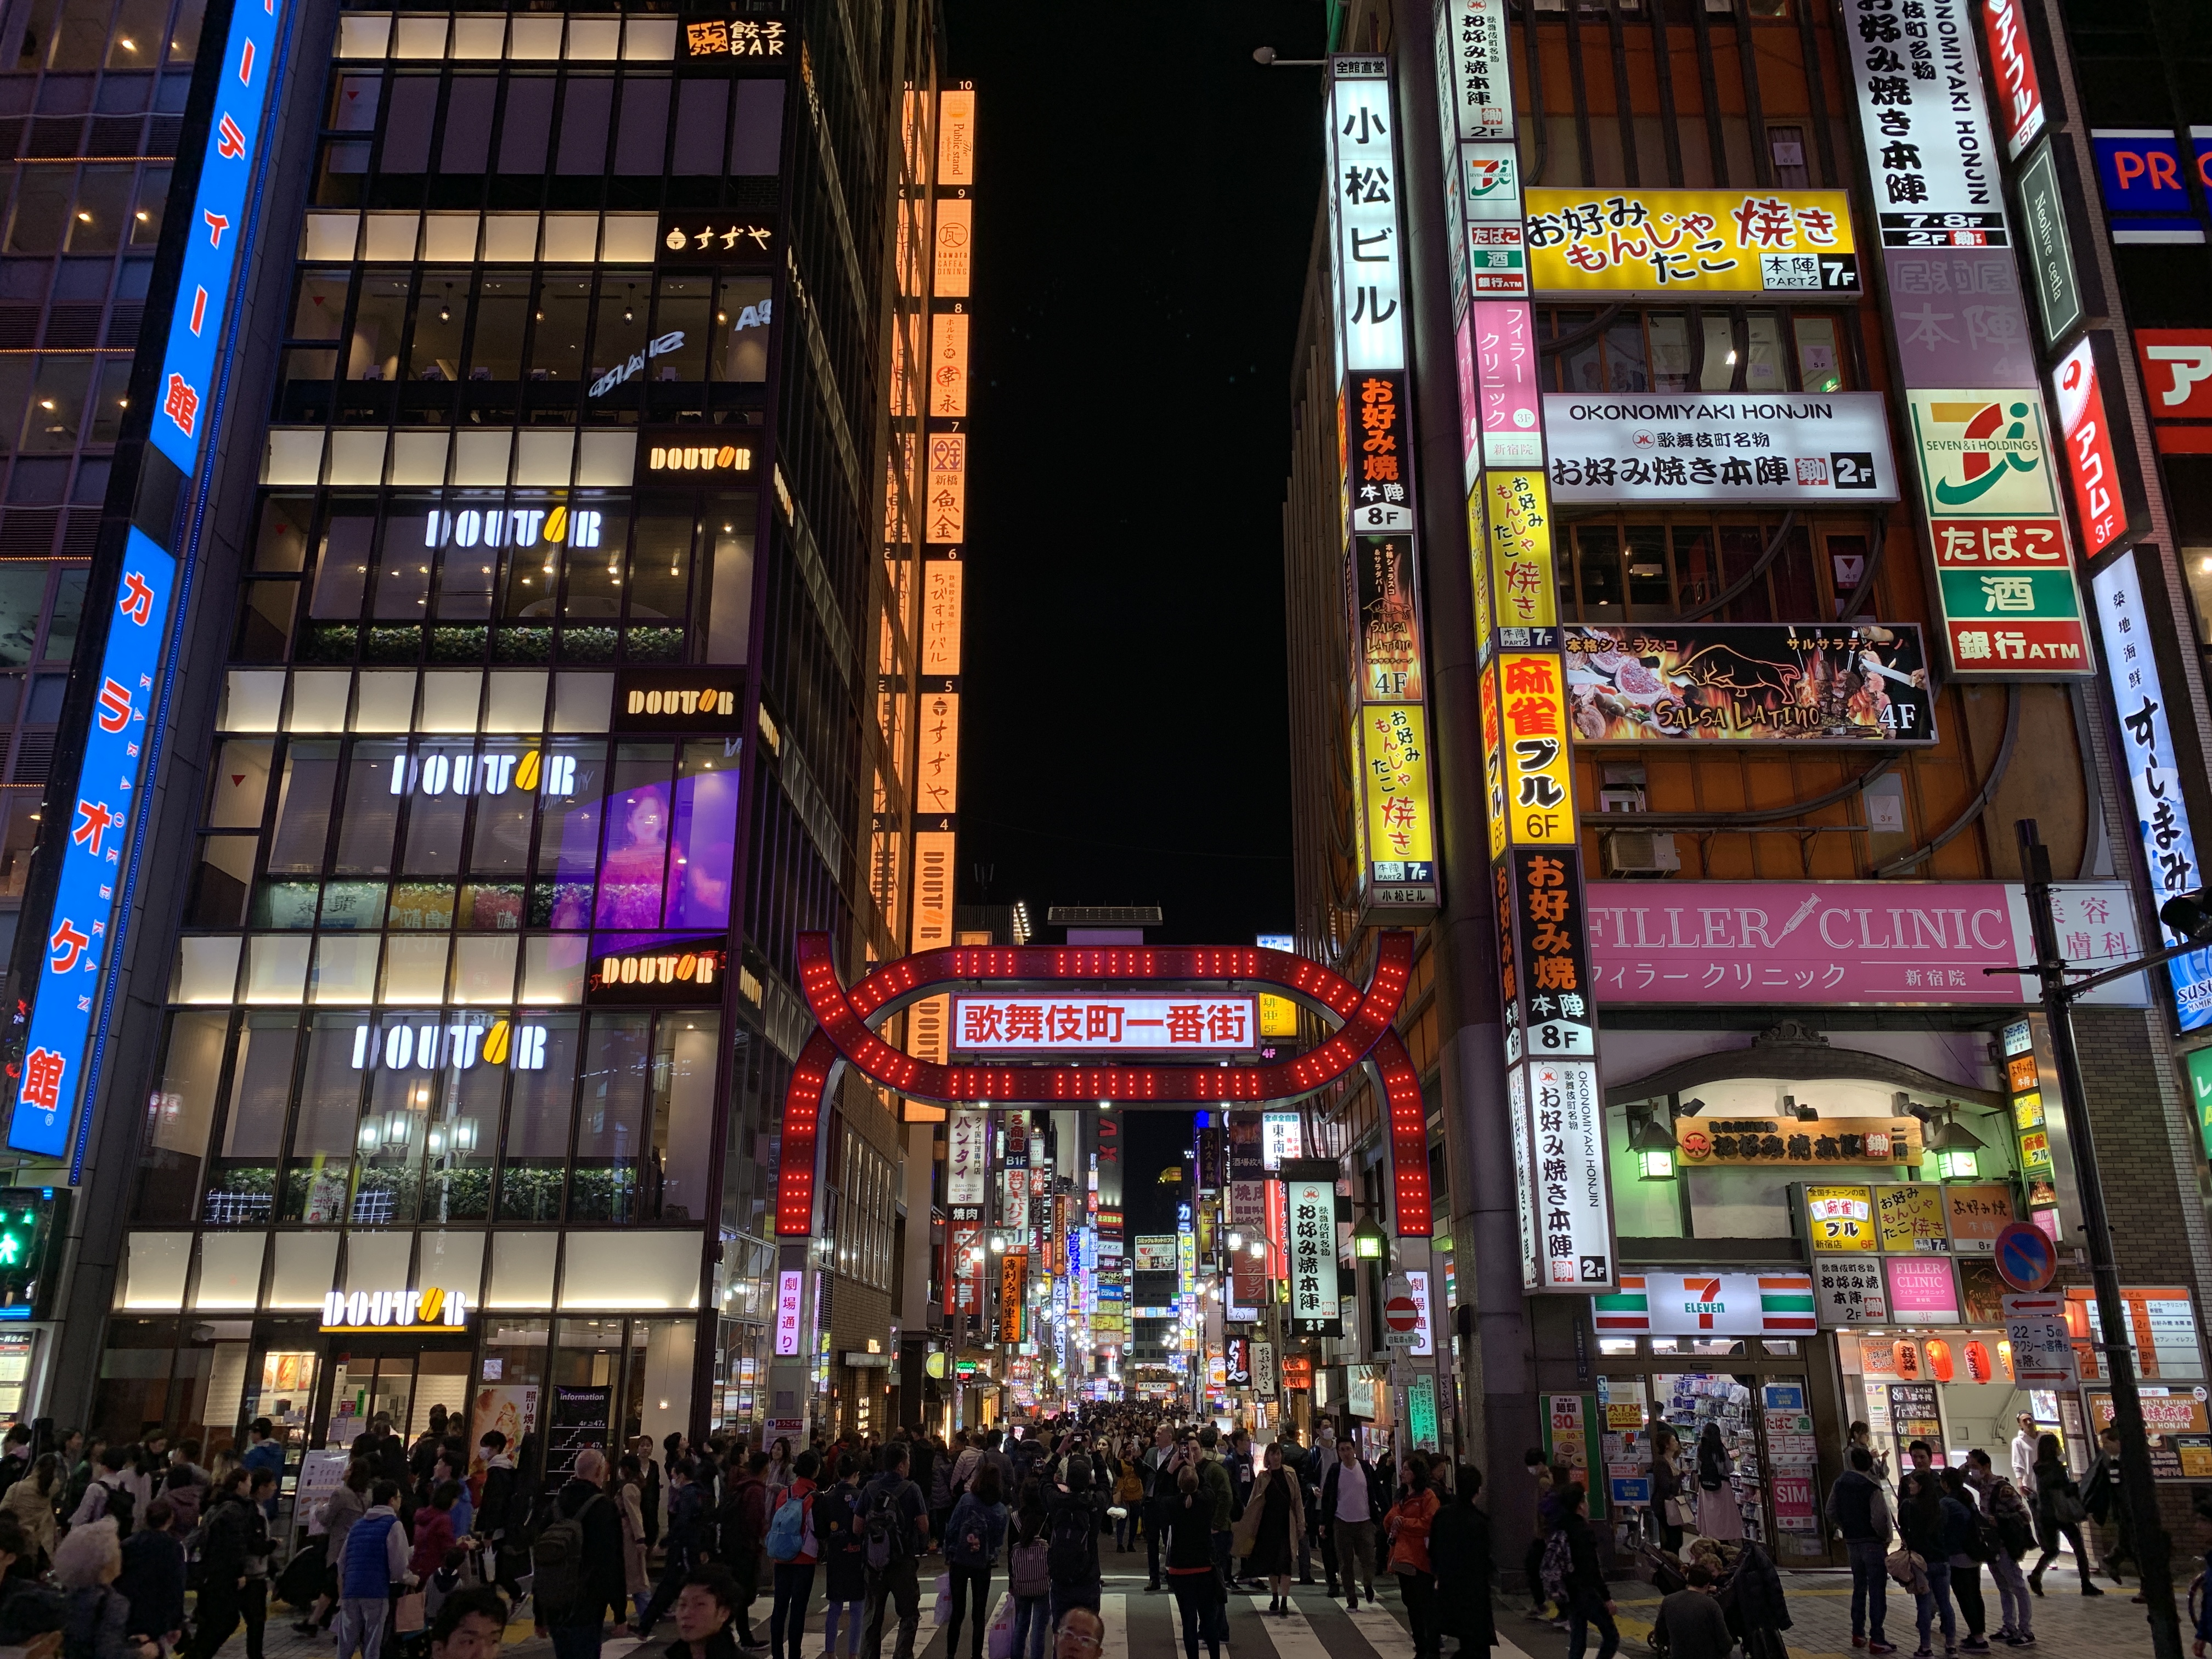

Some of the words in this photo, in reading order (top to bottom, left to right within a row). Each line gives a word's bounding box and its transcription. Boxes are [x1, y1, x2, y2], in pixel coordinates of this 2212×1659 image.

[730, 21, 786, 38] 餃子
[730, 41, 783, 55] BAR
[1336, 61, 1386, 74] 全館直営
[1996, 4, 2032, 125] アイフル
[960, 81, 972, 89] 10
[953, 123, 964, 149] Public
[1470, 126, 1504, 137] 2F
[2019, 119, 2036, 147] 5F
[952, 153, 963, 175] stand
[1955, 121, 1990, 204] HONJIN
[958, 189, 965, 198] 9
[1342, 106, 1397, 325] 小松ビル
[1528, 198, 1647, 246] お好み
[1732, 197, 1837, 250] 焼き
[2035, 190, 2053, 256] Neolive
[694, 225, 771, 250] すずや
[943, 227, 962, 246] 瓦
[1474, 229, 1521, 244] たばこ
[1567, 214, 1715, 272] もんじゃ
[1908, 232, 1946, 245] 2F
[1488, 252, 1508, 267] 酒
[1651, 240, 1737, 284] たこ
[1765, 257, 1815, 274] 本陣
[1479, 277, 1522, 290] 銀行ATM
[1766, 276, 1819, 286] PART2
[1822, 263, 1854, 286] 7F
[955, 304, 962, 313] 8
[1508, 310, 1523, 383] フィラー
[939, 367, 961, 413] 幸永
[1482, 334, 1505, 429] クリニック
[1569, 404, 1735, 420] OKONOMIYAKI
[1742, 403, 1832, 420] HONJIN
[951, 422, 959, 432] 7
[1361, 379, 1399, 481] お好み焼
[1493, 444, 1533, 456] 新宿院
[1657, 432, 1770, 448] 歌舞伎町名物
[1978, 440, 2038, 452] HOLDINGS
[651, 446, 751, 470] DOUTOR
[935, 475, 958, 486] 新橋
[1551, 456, 1791, 486] お好み焼き本陣
[1837, 459, 1872, 483] 2F
[2076, 421, 2111, 519] アコム
[1360, 484, 1406, 503] 本陣
[932, 489, 961, 538] 魚金
[1367, 508, 1398, 526] 8F
[2096, 516, 2114, 544] 3F
[949, 549, 957, 559] 6
[1941, 526, 2061, 561] たばこ
[1385, 544, 1395, 595] 本格シュラスコ
[1504, 561, 1541, 620] 焼き
[1980, 575, 2036, 612] 酒
[930, 573, 947, 662] ちびすけバル
[1533, 628, 1551, 645] 7F
[1567, 637, 1679, 653] 本格シュラスコ
[1787, 637, 1904, 651] サルサラティーノ
[1957, 630, 2080, 659] 銀行ATM
[2113, 589, 2142, 691] 築地海鮮
[945, 681, 952, 692] 5
[1374, 672, 1408, 695] 4F
[628, 689, 733, 714] DOUTOR
[1506, 658, 1558, 735] 麻雀
[1878, 704, 1915, 730] 4F
[926, 720, 949, 810] すずや
[1513, 738, 1564, 808] ブル
[940, 819, 949, 830] 4
[1381, 796, 1417, 856] 焼き
[1527, 815, 1559, 837] 6F
[20, 571, 155, 1111] カラオケ館
[1407, 863, 1427, 880] 7F
[921, 852, 945, 939] DOUTOR
[1383, 889, 1426, 902] 小松ビル
[1527, 856, 1577, 989] お好み焼
[1588, 907, 1778, 949] FILLER
[1819, 907, 2007, 950] CLINIC
[603, 955, 714, 984] DOUTOR
[1701, 963, 1845, 990] クリニック
[1905, 969, 1966, 986] 新宿院
[1532, 993, 1584, 1018] 本陣
[964, 1004, 1245, 1043] 歌舞伎町一番街
[1542, 1025, 1579, 1048] 8F
[1564, 1070, 1578, 1131] 歌舞伎町名物
[1578, 1071, 1596, 1156] OKONOMIYAKI
[955, 1116, 972, 1180] バンタイ
[974, 1117, 982, 1175] タイ国料理専門店
[1006, 1156, 1026, 1165] B1F
[1539, 1087, 1573, 1258] お好み焼き本陣
[1585, 1159, 1599, 1207] HONJIN
[1810, 1189, 1865, 1197] 全国チェーンの店
[953, 1209, 978, 1220] 焼肉
[1826, 1200, 1853, 1216] 麻雀
[1954, 1199, 2006, 1217] お好み焼
[1319, 1207, 1330, 1256] 歌舞伎町名物
[1826, 1221, 1860, 1238] ブル
[1815, 1240, 1842, 1249] 新宿店
[1297, 1204, 1319, 1310] お好み焼本陣
[1822, 1264, 1875, 1273] 歌舞伎町名物
[1896, 1263, 1940, 1274] FILLER
[1583, 1261, 1605, 1278] 2F
[1897, 1277, 1943, 1288] CLINIC
[322, 1288, 466, 1326] DOUTOR
[782, 1278, 797, 1348] 劇場通り
[1306, 1320, 1324, 1331] 2F
[2013, 1340, 2069, 1353] タクシーの客待ち
[2015, 1356, 2041, 1369] を除く
[1426, 1379, 1436, 1453] みなさまの安全を守ります
[1553, 1414, 1574, 1429] 30
[1765, 1418, 1793, 1429] たばこ
[1777, 1486, 1808, 1503] SIM
